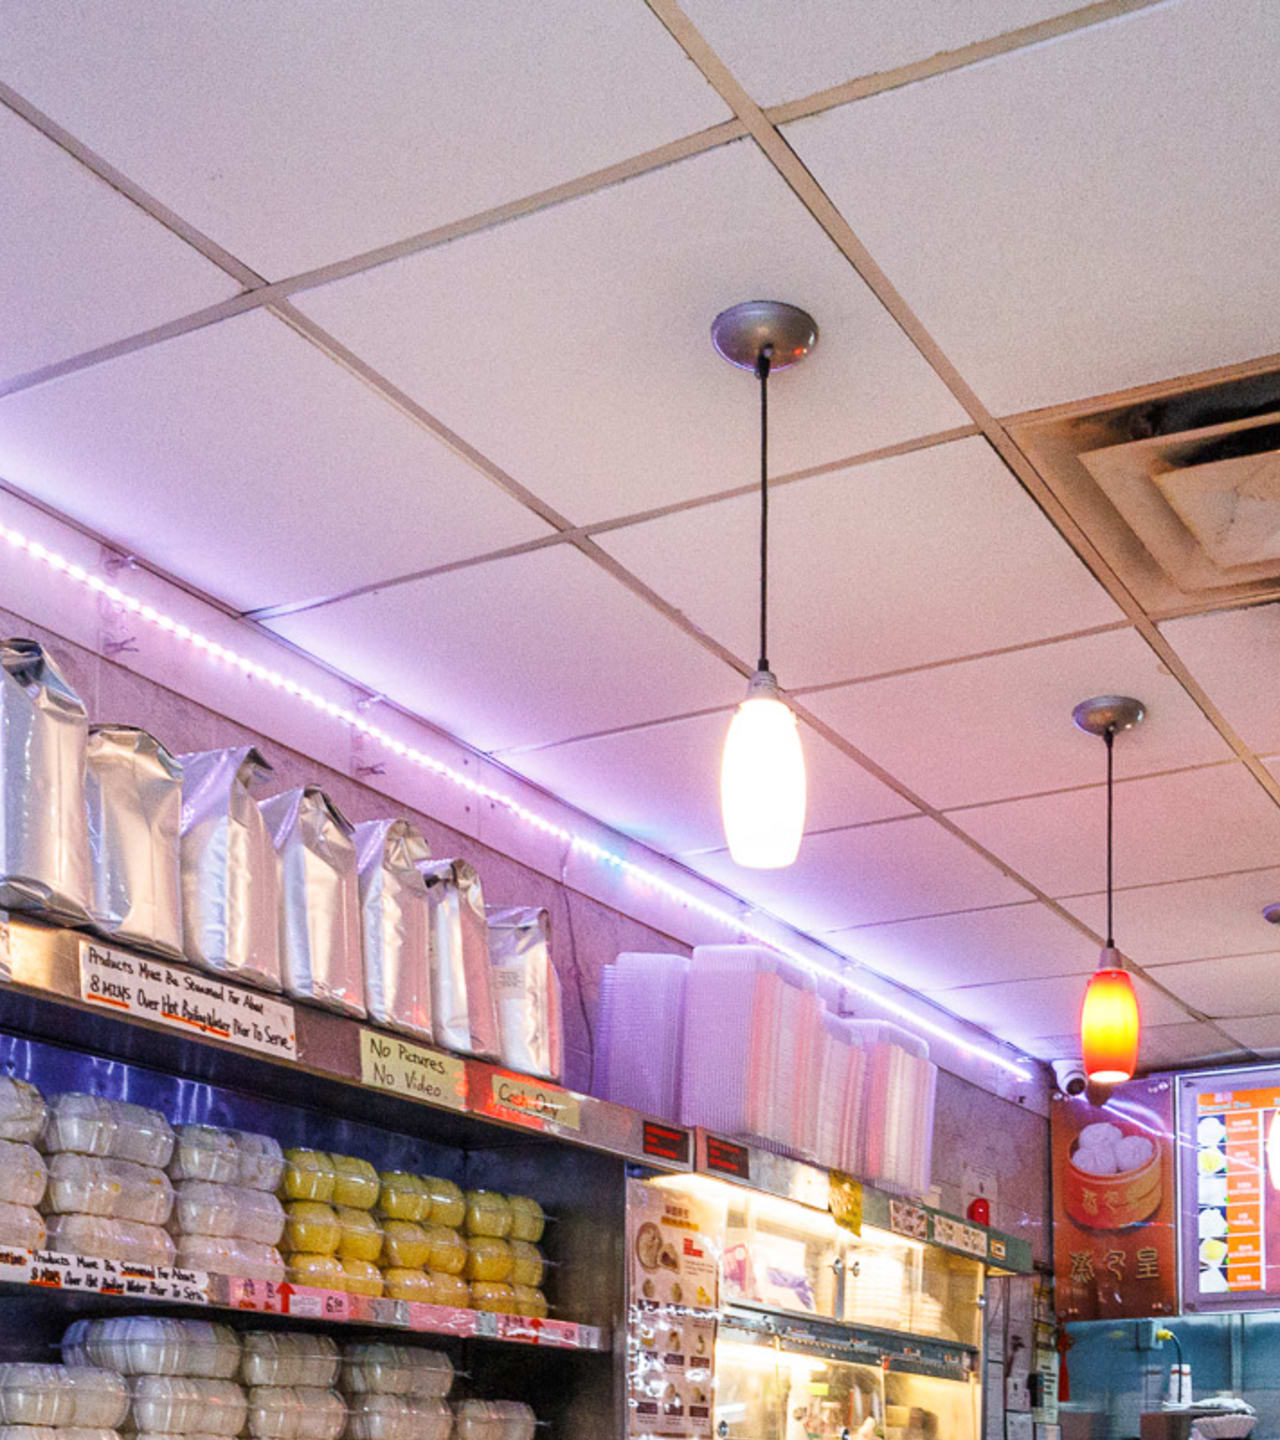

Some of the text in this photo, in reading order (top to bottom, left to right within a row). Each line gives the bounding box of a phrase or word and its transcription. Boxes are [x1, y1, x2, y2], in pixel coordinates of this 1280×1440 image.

[87, 946, 135, 975] Products
[136, 988, 160, 1011] Over
[161, 994, 180, 1016] Hot
[370, 1038, 447, 1075] No Pictures
[373, 1062, 396, 1087] No
